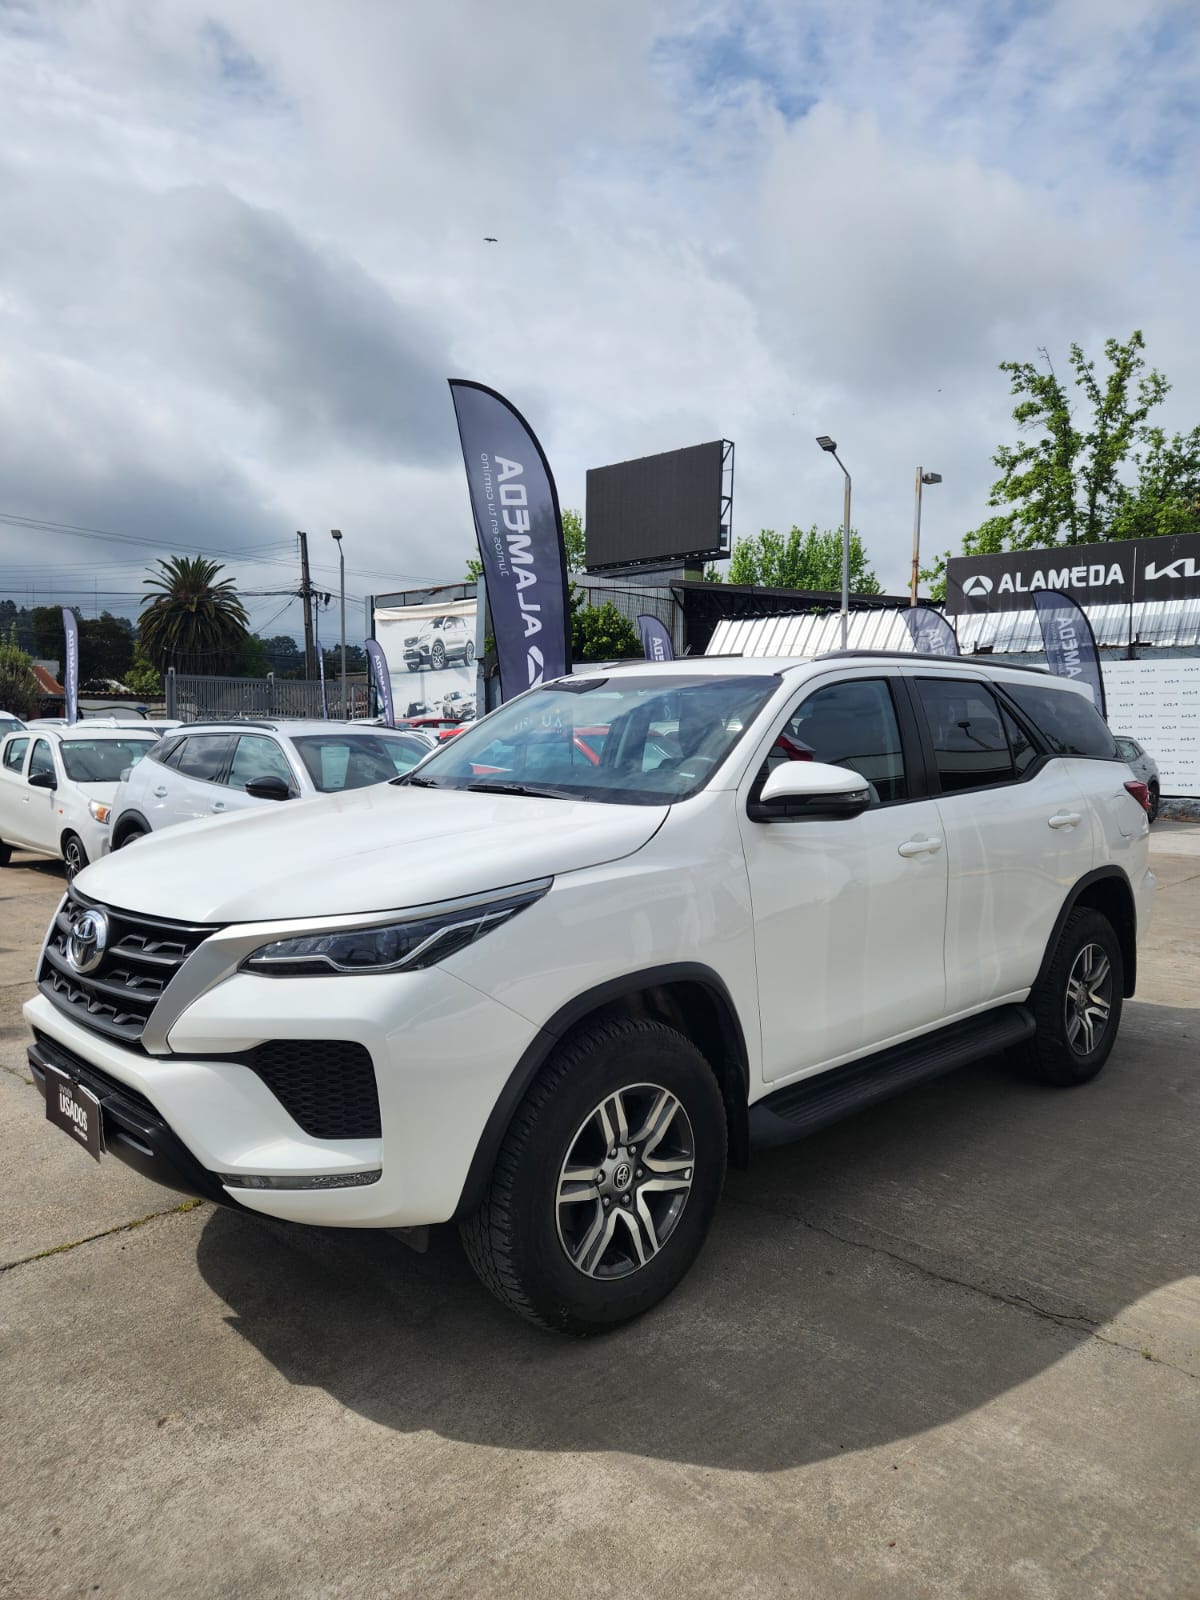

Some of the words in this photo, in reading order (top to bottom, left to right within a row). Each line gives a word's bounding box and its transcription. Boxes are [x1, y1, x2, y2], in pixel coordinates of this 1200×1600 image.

[997, 563, 1125, 594] ALAMEDA
[1144, 558, 1200, 580] KI
[59, 1093, 87, 1131] USADOS
